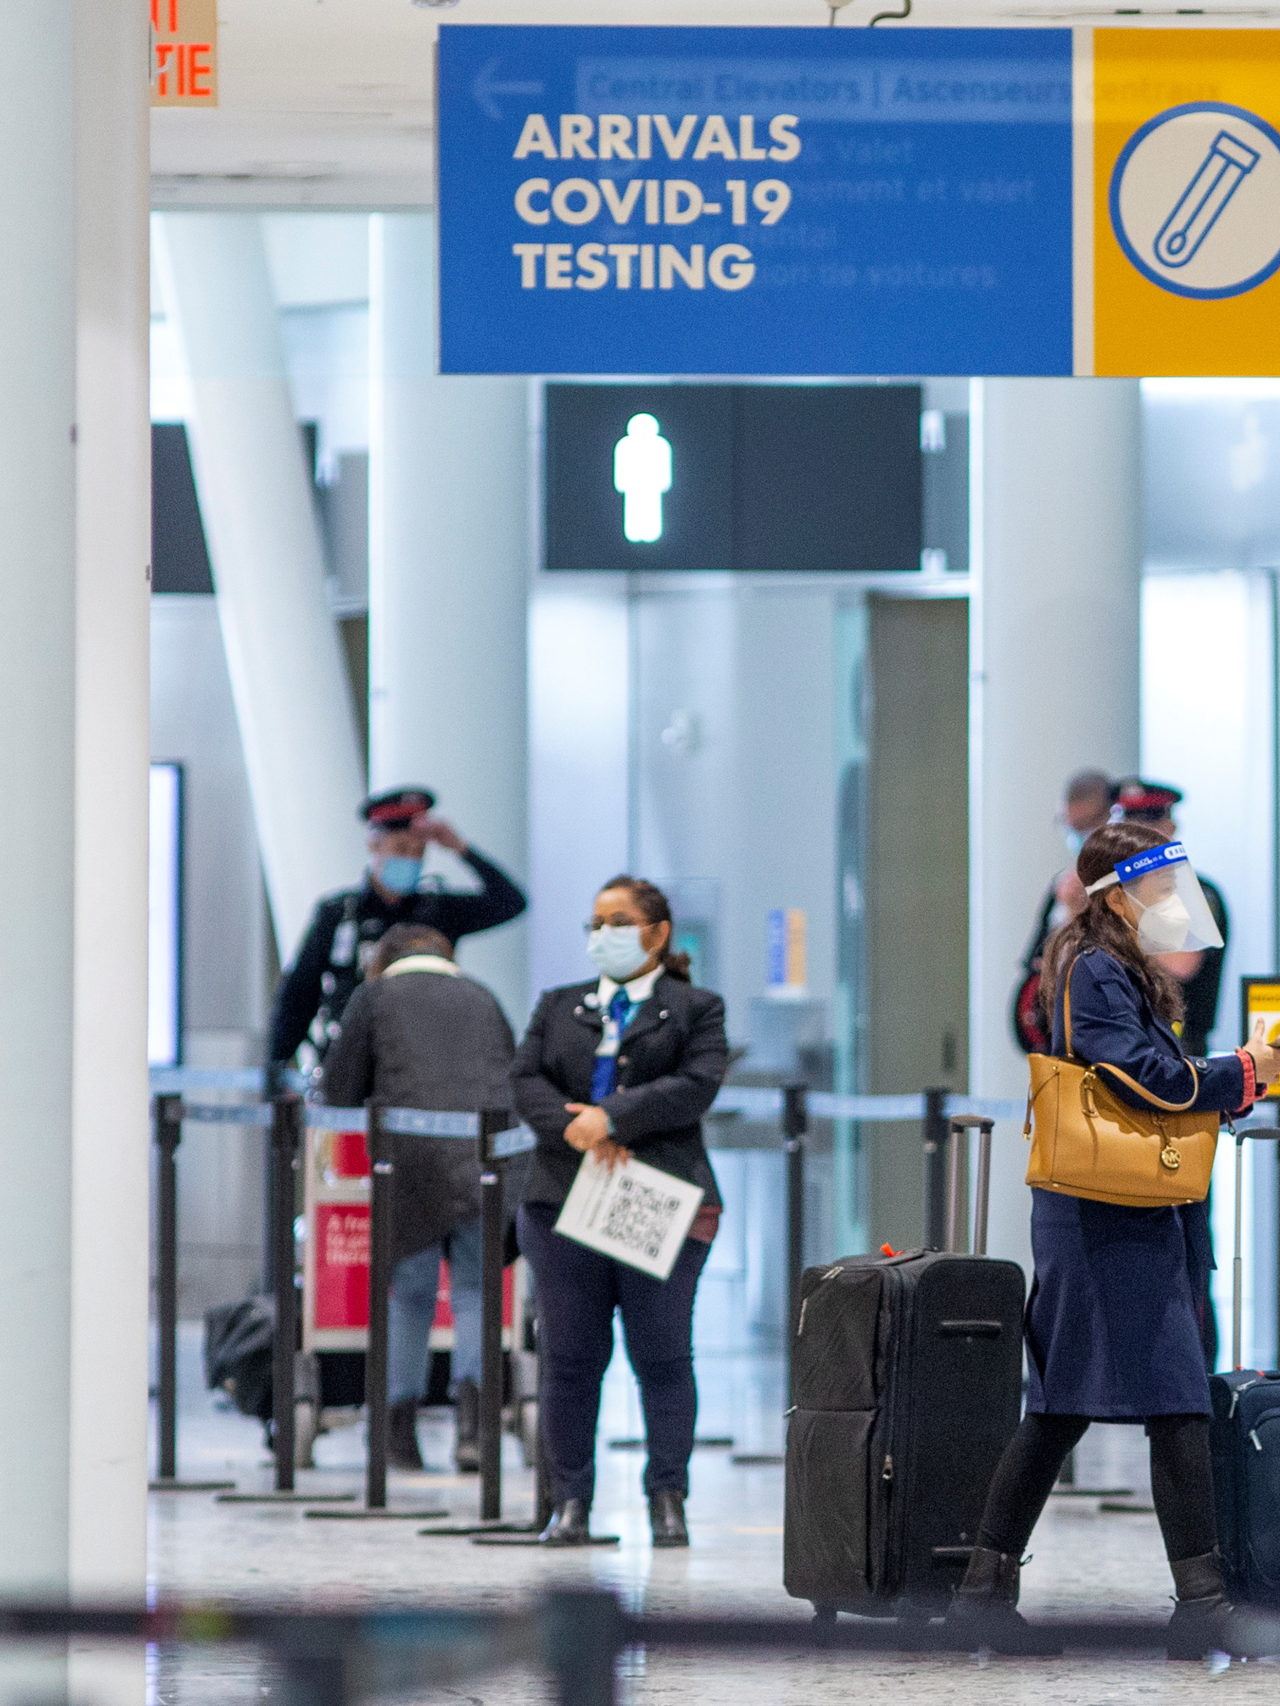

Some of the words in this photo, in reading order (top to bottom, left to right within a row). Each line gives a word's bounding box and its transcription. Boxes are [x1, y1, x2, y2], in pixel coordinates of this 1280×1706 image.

[155, 44, 211, 97] TIE
[588, 71, 704, 102] Central
[715, 71, 860, 102] Elevators
[514, 113, 802, 163] ARRIVALS
[515, 177, 792, 226] COVID-19
[513, 243, 757, 292] TESTING
